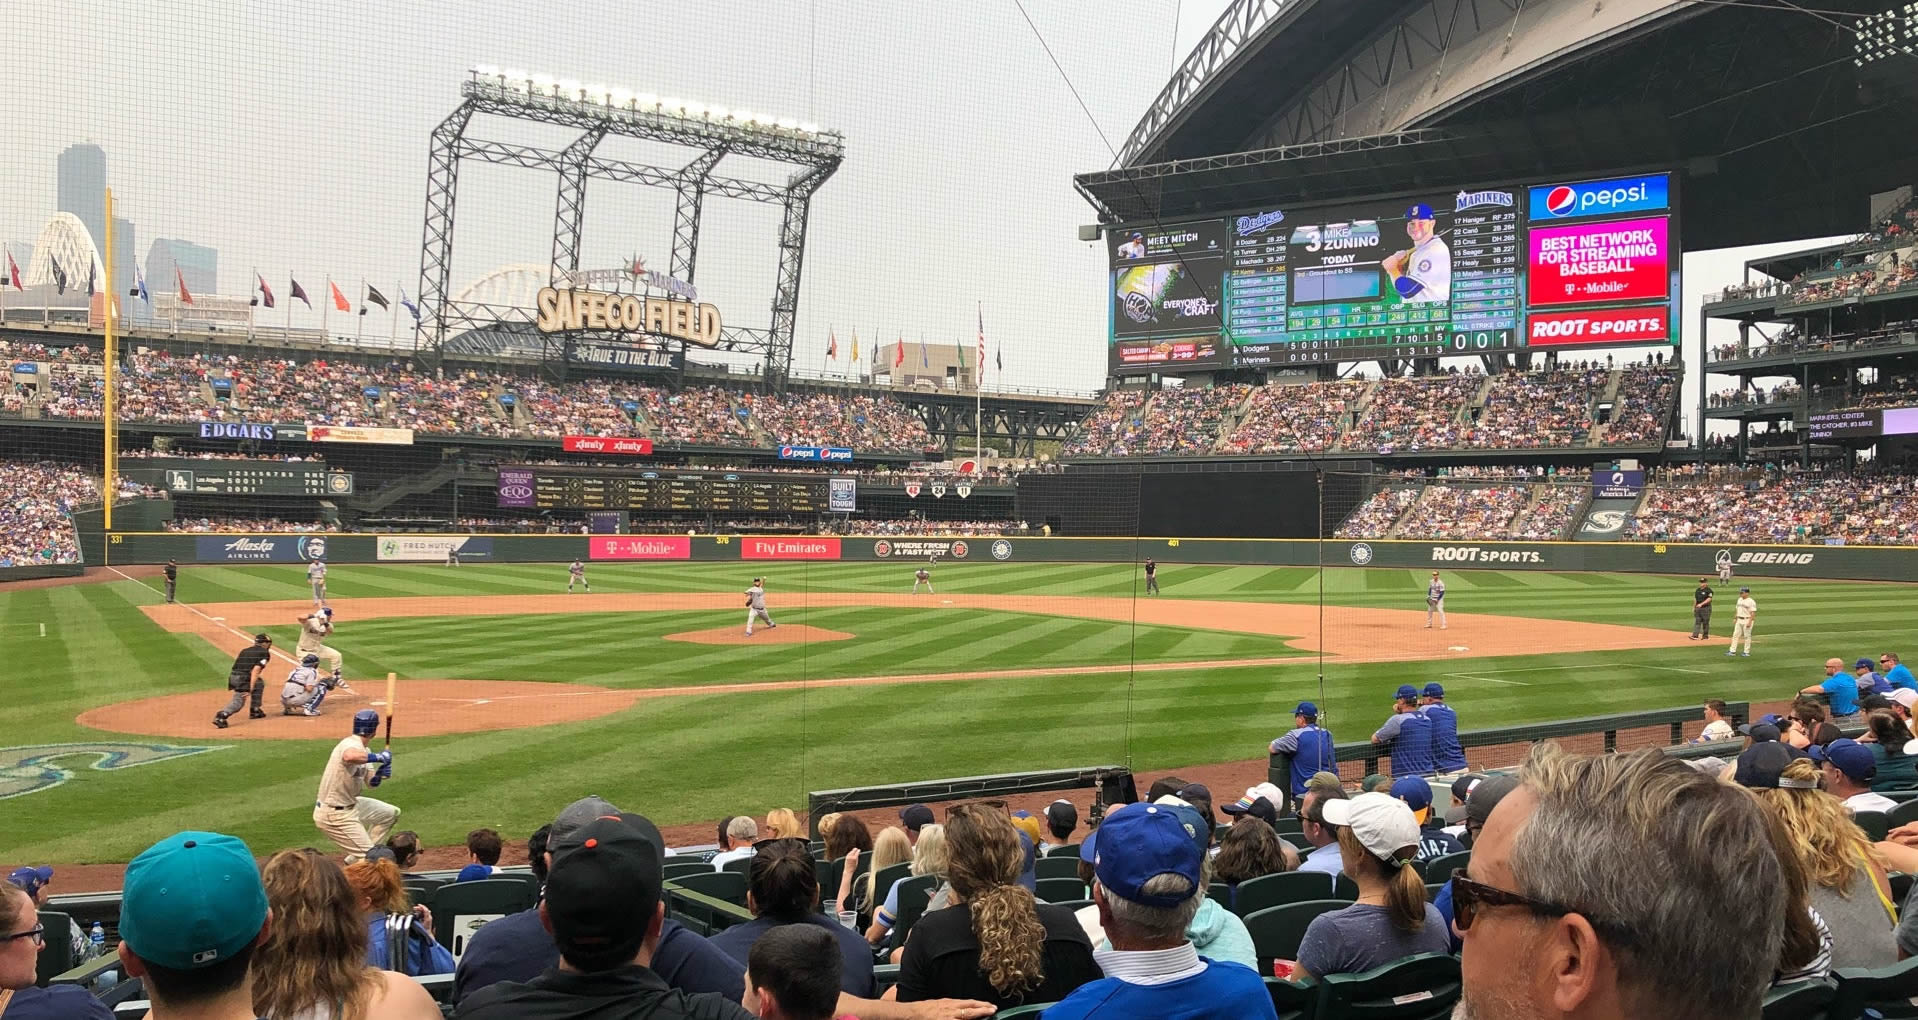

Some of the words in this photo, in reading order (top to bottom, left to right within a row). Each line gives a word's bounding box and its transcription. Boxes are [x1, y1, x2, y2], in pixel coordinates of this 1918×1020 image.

[1455, 191, 1513, 212] MARINERS
[1582, 182, 1648, 210] pepsi
[1237, 210, 1284, 236] Dodgers
[1463, 216, 1485, 224] Haniger
[1147, 236, 1169, 246] MEET
[1171, 233, 1198, 243] MITCH
[1305, 231, 1321, 252] 3
[1325, 228, 1349, 239] MIKE
[1324, 236, 1379, 251] ZUNINO
[1541, 236, 1577, 251] BEST
[1580, 229, 1654, 249] NETWORK
[1321, 254, 1356, 265] TODAY
[1539, 251, 1567, 265] FOR
[1570, 243, 1657, 261] STREAMING
[1560, 259, 1635, 277] BASEBALL
[1163, 297, 1208, 309] EVERYONE'S
[1184, 303, 1216, 316] CRAFT
[538, 287, 642, 333] SAFECO
[645, 297, 722, 347] FIELD
[1533, 320, 1588, 338] ROOT
[1590, 318, 1660, 335] SPORTS
[1243, 345, 1270, 354] Dodgers
[1408, 335, 1418, 343] 10
[1455, 334, 1466, 350] 0
[1477, 333, 1488, 349] 0
[1499, 331, 1507, 347] 1
[587, 346, 613, 363] TRUE
[615, 351, 628, 363] TO
[629, 353, 646, 365] THE
[648, 352, 674, 367] BLUE
[1243, 356, 1271, 365] Mariners
[201, 423, 273, 440] EDGARS
[575, 440, 605, 450] xfinity
[614, 441, 642, 451] xfinity
[793, 450, 815, 459] pepsi
[831, 451, 852, 460] pepsi
[502, 486, 530, 499] EQC
[832, 482, 853, 491] BUILT
[908, 486, 918, 494] 42
[934, 486, 943, 494] 24
[961, 487, 968, 495] 11
[832, 500, 853, 508] TOUGH
[111, 535, 123, 544] 331
[225, 537, 275, 552] Alaska
[428, 542, 457, 550] HUTCH
[716, 536, 729, 545] 376
[1168, 539, 1180, 547] 401
[756, 542, 776, 555] Fly
[777, 542, 827, 553] Emirates
[1432, 547, 1481, 561] ROOT
[1480, 551, 1540, 563] SPORTS
[1737, 552, 1815, 565] BOEING
